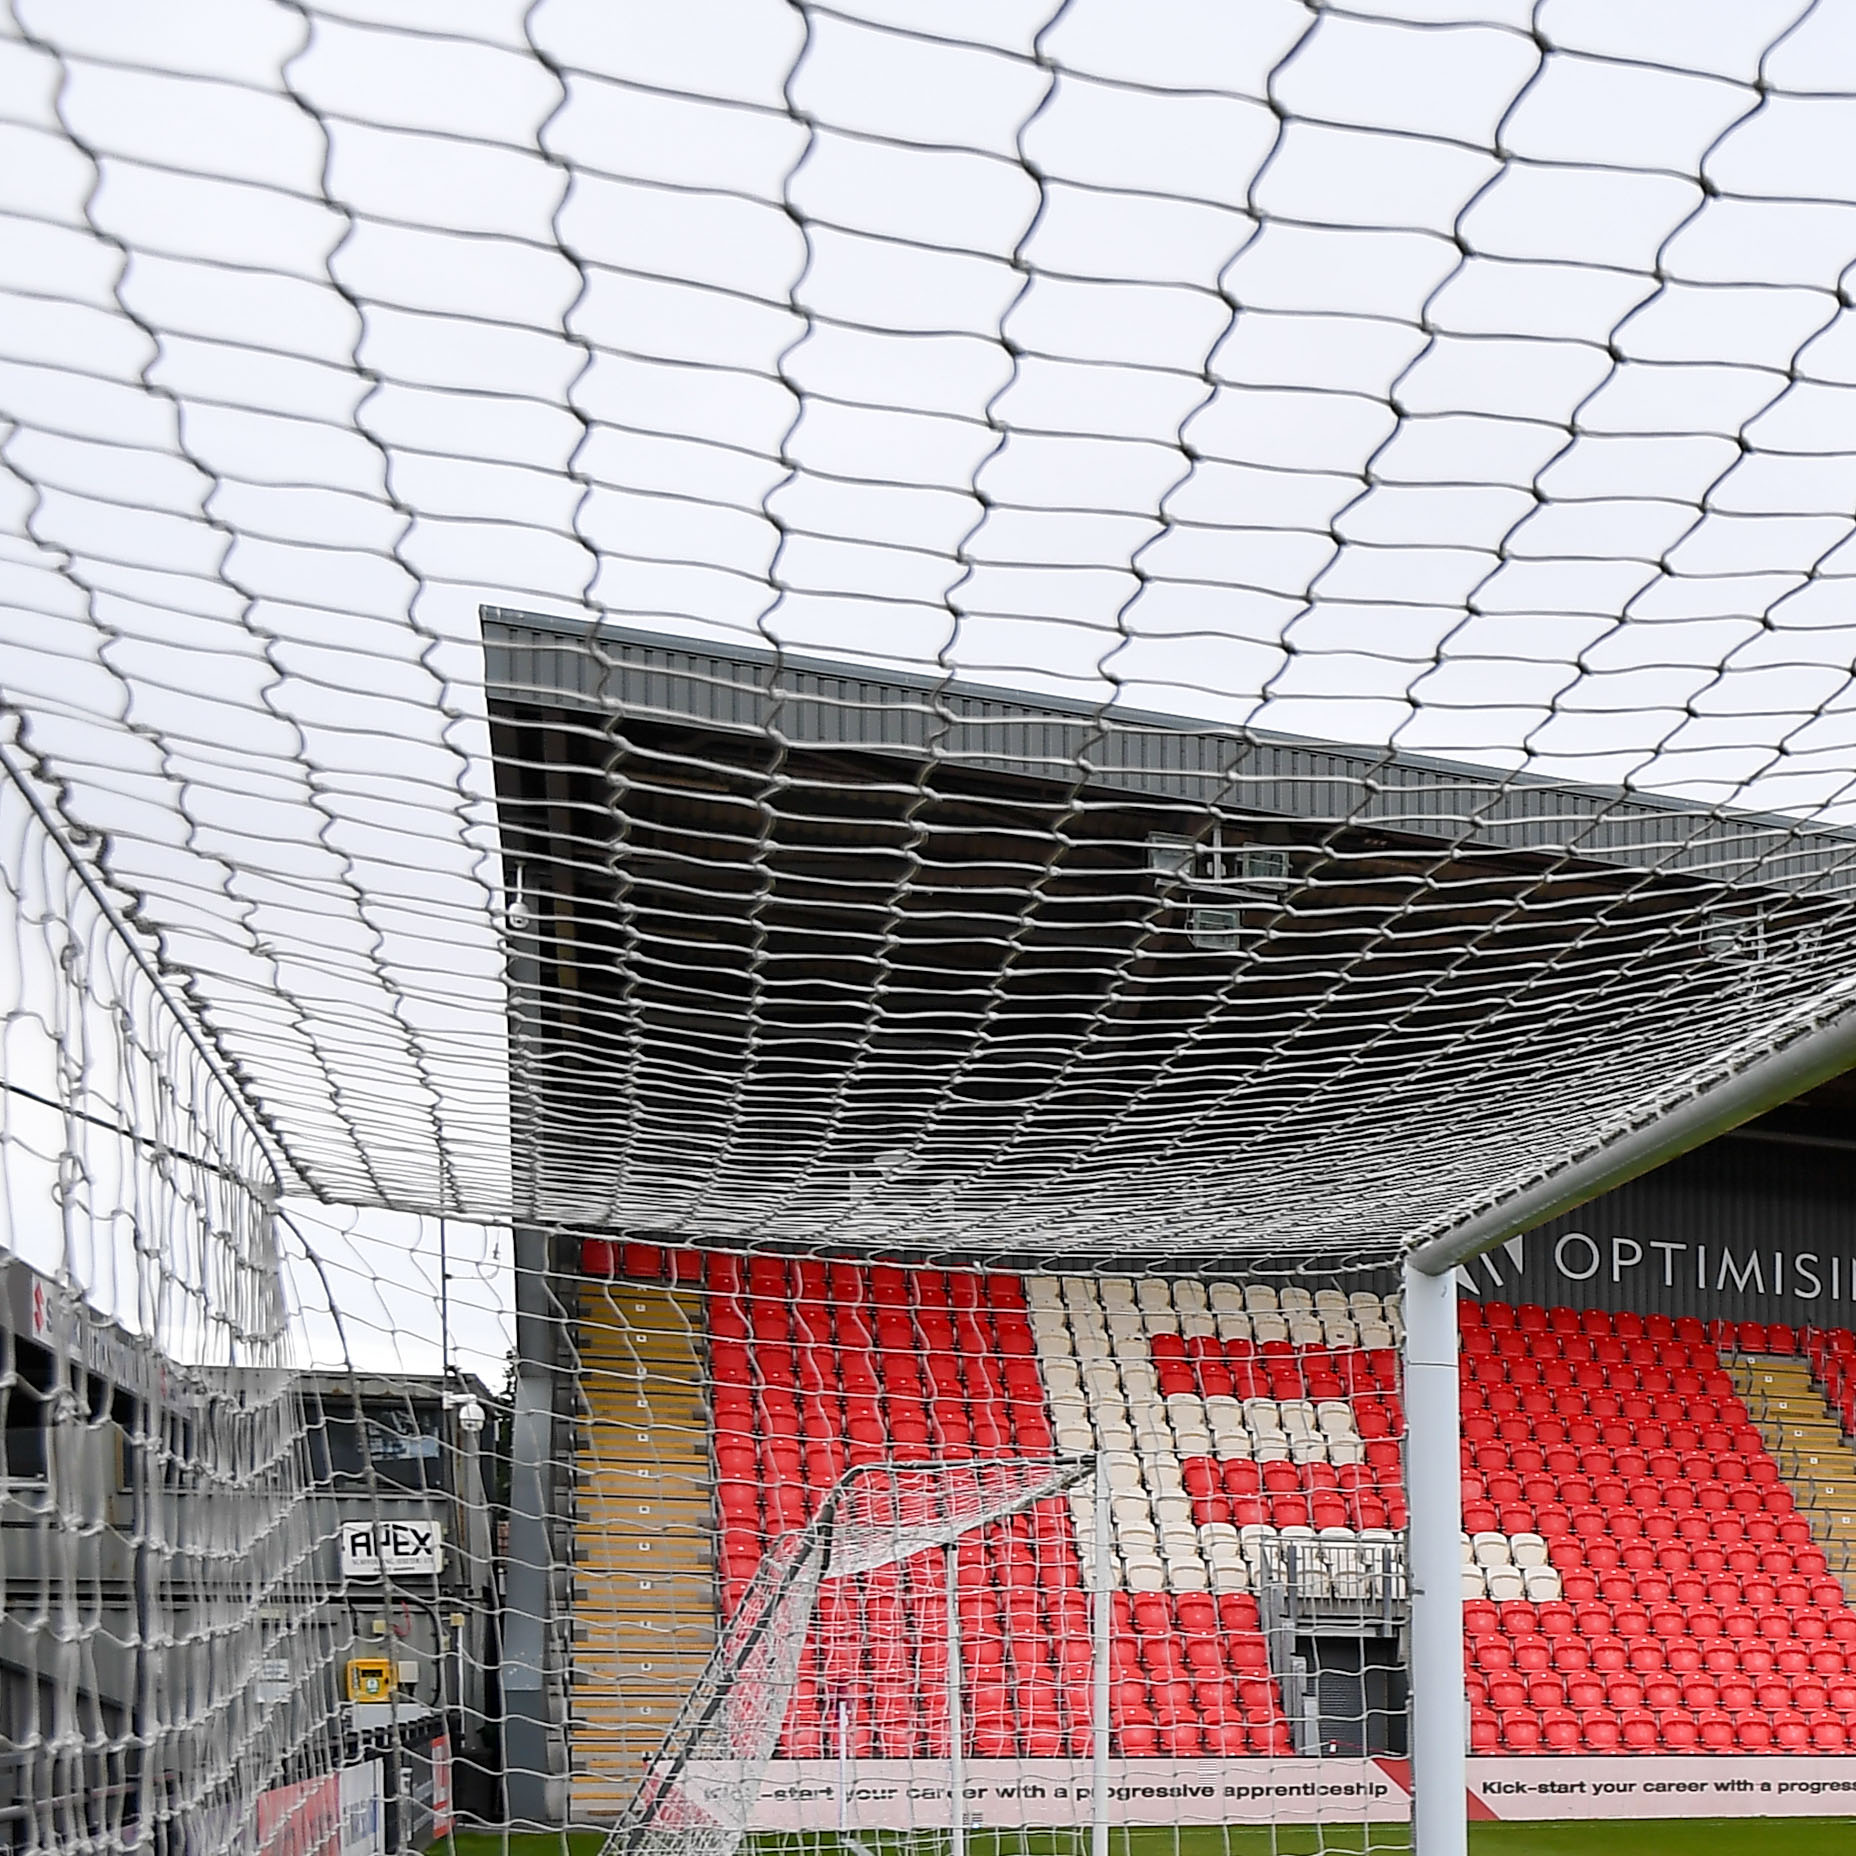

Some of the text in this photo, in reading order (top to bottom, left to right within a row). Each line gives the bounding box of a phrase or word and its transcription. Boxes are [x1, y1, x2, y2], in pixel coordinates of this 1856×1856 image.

[995, 1785, 1045, 1799] with
[1054, 1788, 1067, 1799] a
[1076, 1785, 1215, 1801] pgressive
[1224, 1782, 1388, 1801] apprenticeship
[1482, 1780, 1587, 1794] Kick-start
[1592, 1782, 1637, 1795] your
[1643, 1781, 1708, 1792] career
[1714, 1780, 1754, 1792] with
[1760, 1781, 1771, 1791] a
